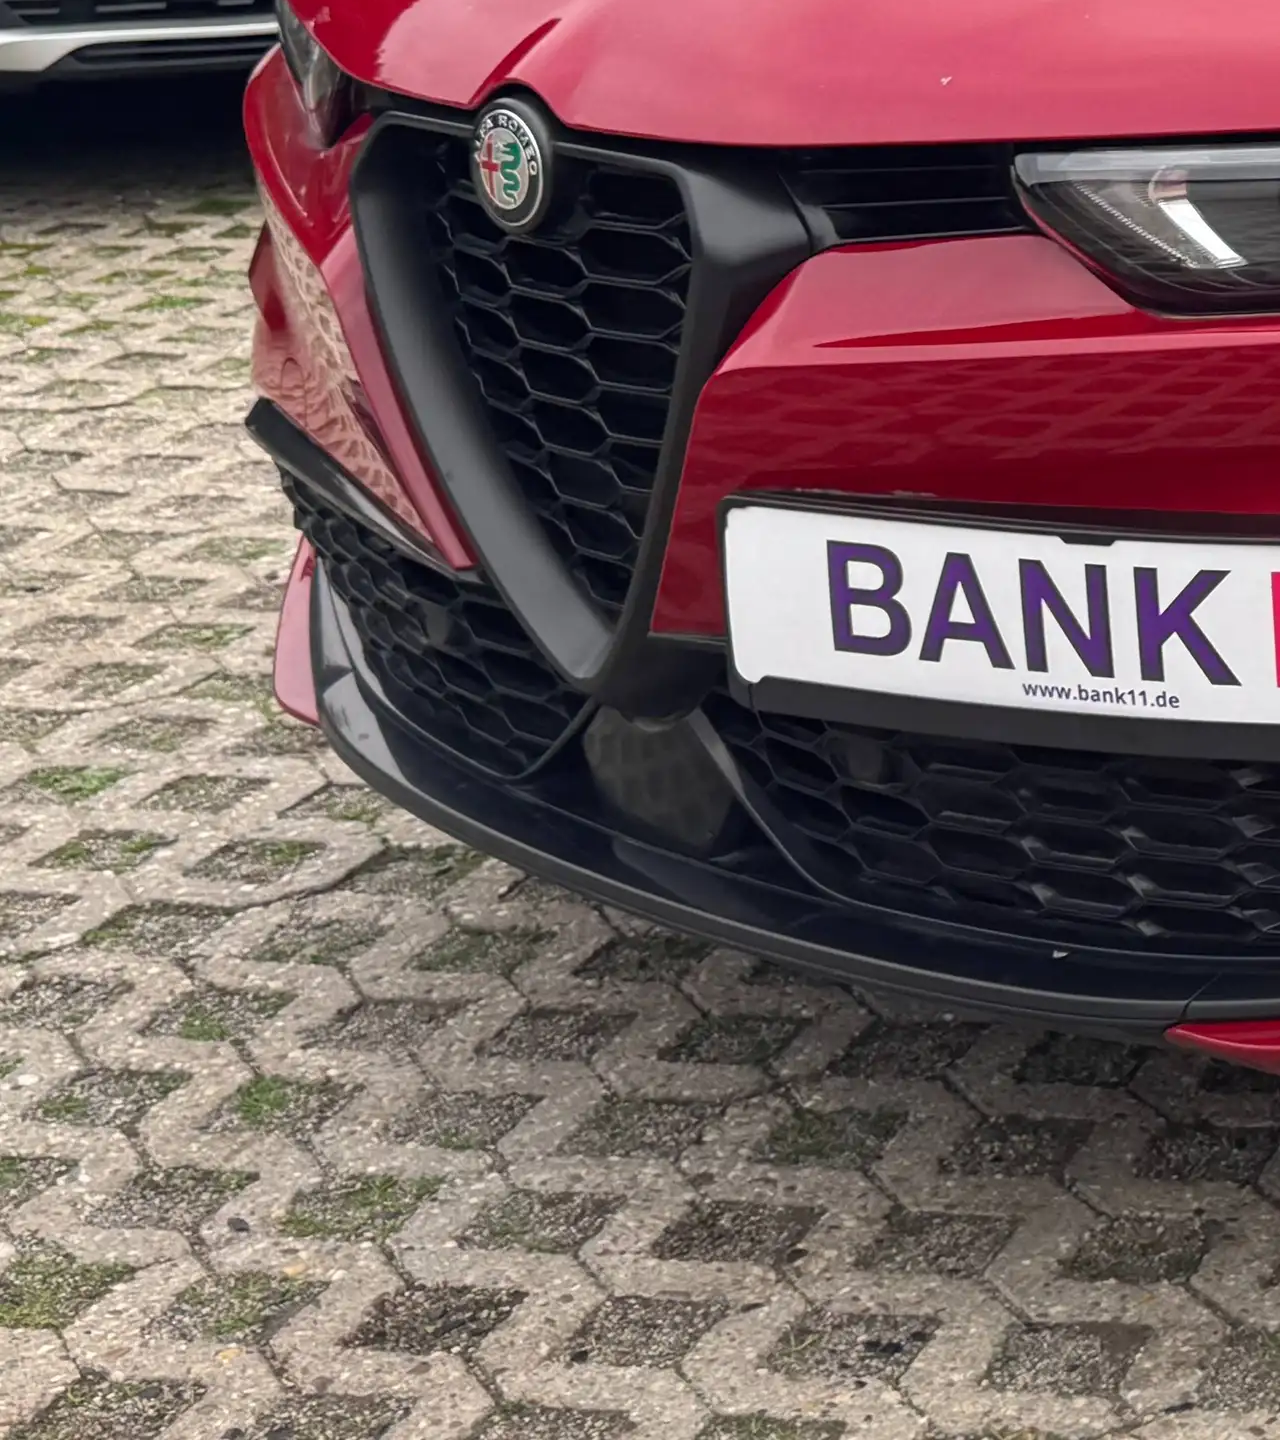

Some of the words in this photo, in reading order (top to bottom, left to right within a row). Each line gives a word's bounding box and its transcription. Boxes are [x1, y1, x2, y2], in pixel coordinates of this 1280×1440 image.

[498, 114, 538, 176] ROMEO
[826, 539, 1243, 687] BANK
[1021, 682, 1181, 709] www.bank11.de
